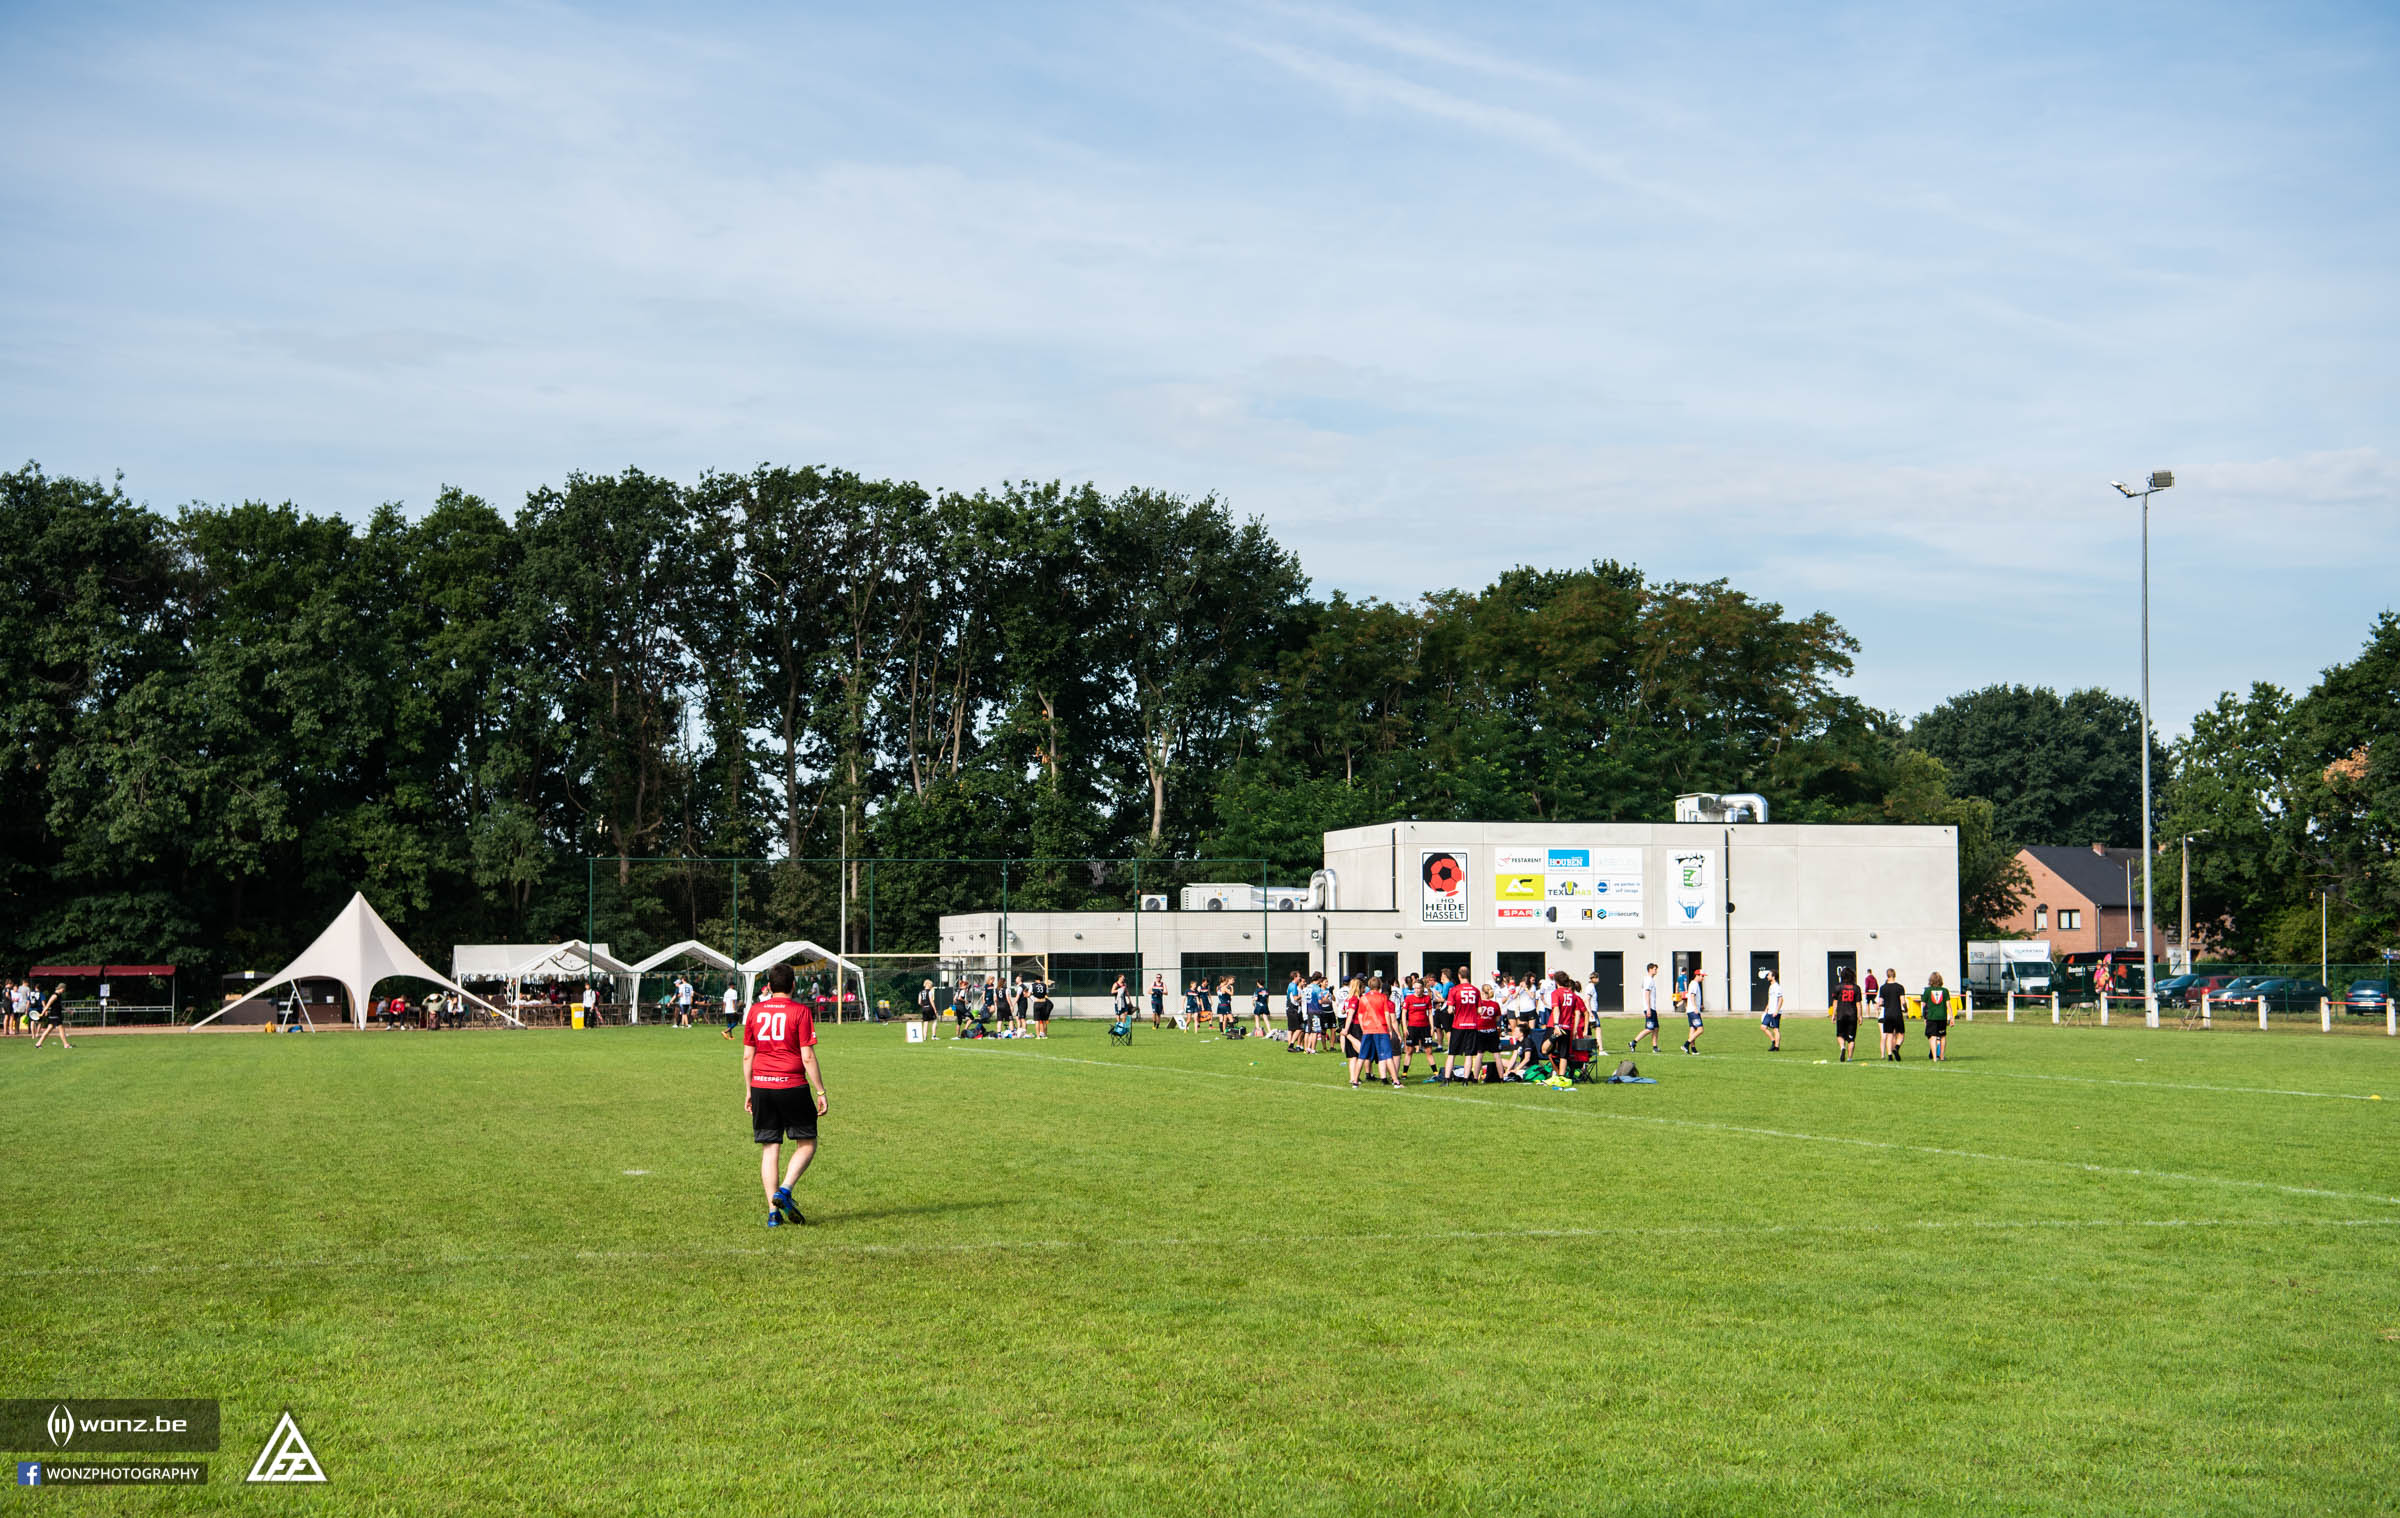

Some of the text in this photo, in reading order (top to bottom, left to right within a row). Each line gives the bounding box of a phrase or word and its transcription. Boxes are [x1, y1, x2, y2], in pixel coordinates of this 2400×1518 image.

[1549, 858, 1583, 867] HOUBEN
[1425, 911, 1465, 920] HASSELT
[1460, 990, 1476, 1004] 55
[1562, 993, 1573, 1006] 15
[756, 1012, 786, 1041] 20
[912, 1028, 918, 1038] 1
